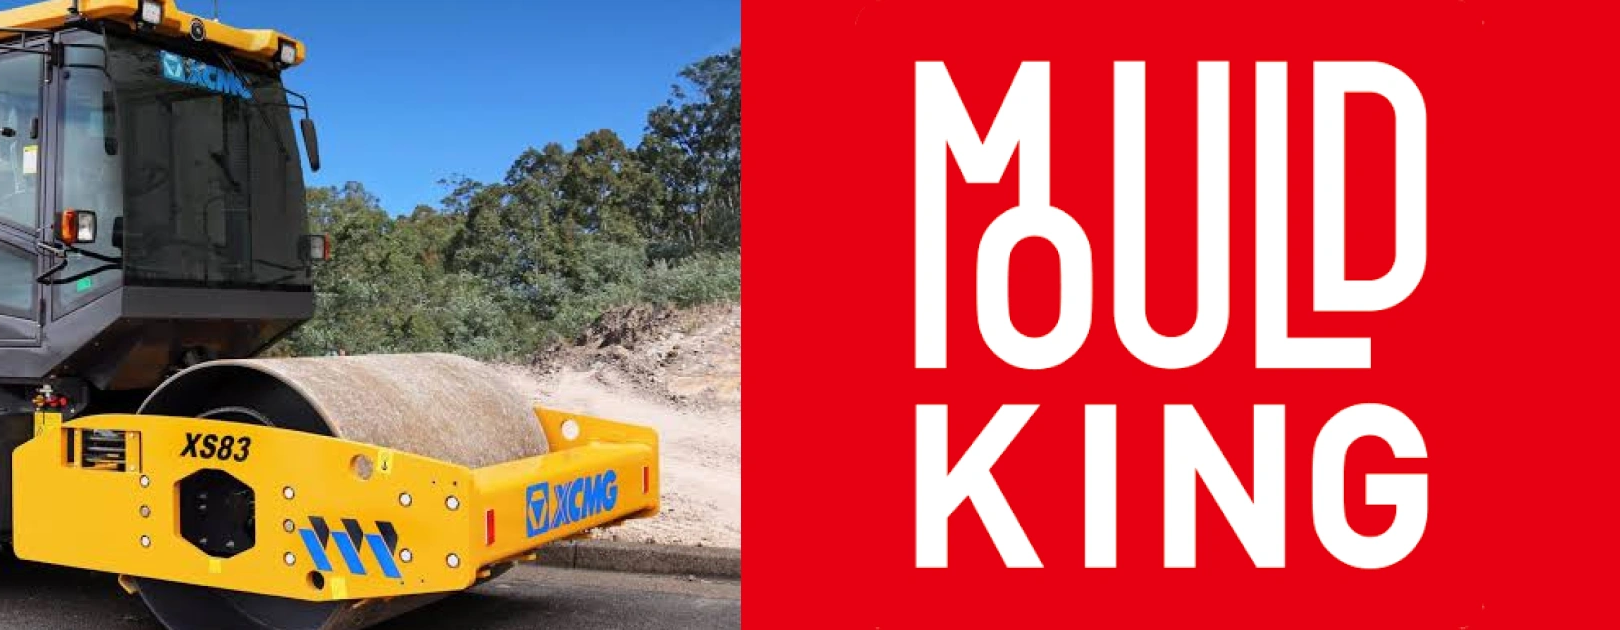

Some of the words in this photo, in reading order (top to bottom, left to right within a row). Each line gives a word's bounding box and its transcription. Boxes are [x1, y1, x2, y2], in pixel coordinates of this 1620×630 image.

[916, 61, 1427, 370] MOULD
[180, 432, 251, 462] XS83
[551, 469, 618, 528] XCMG
[916, 403, 1428, 570] KING
